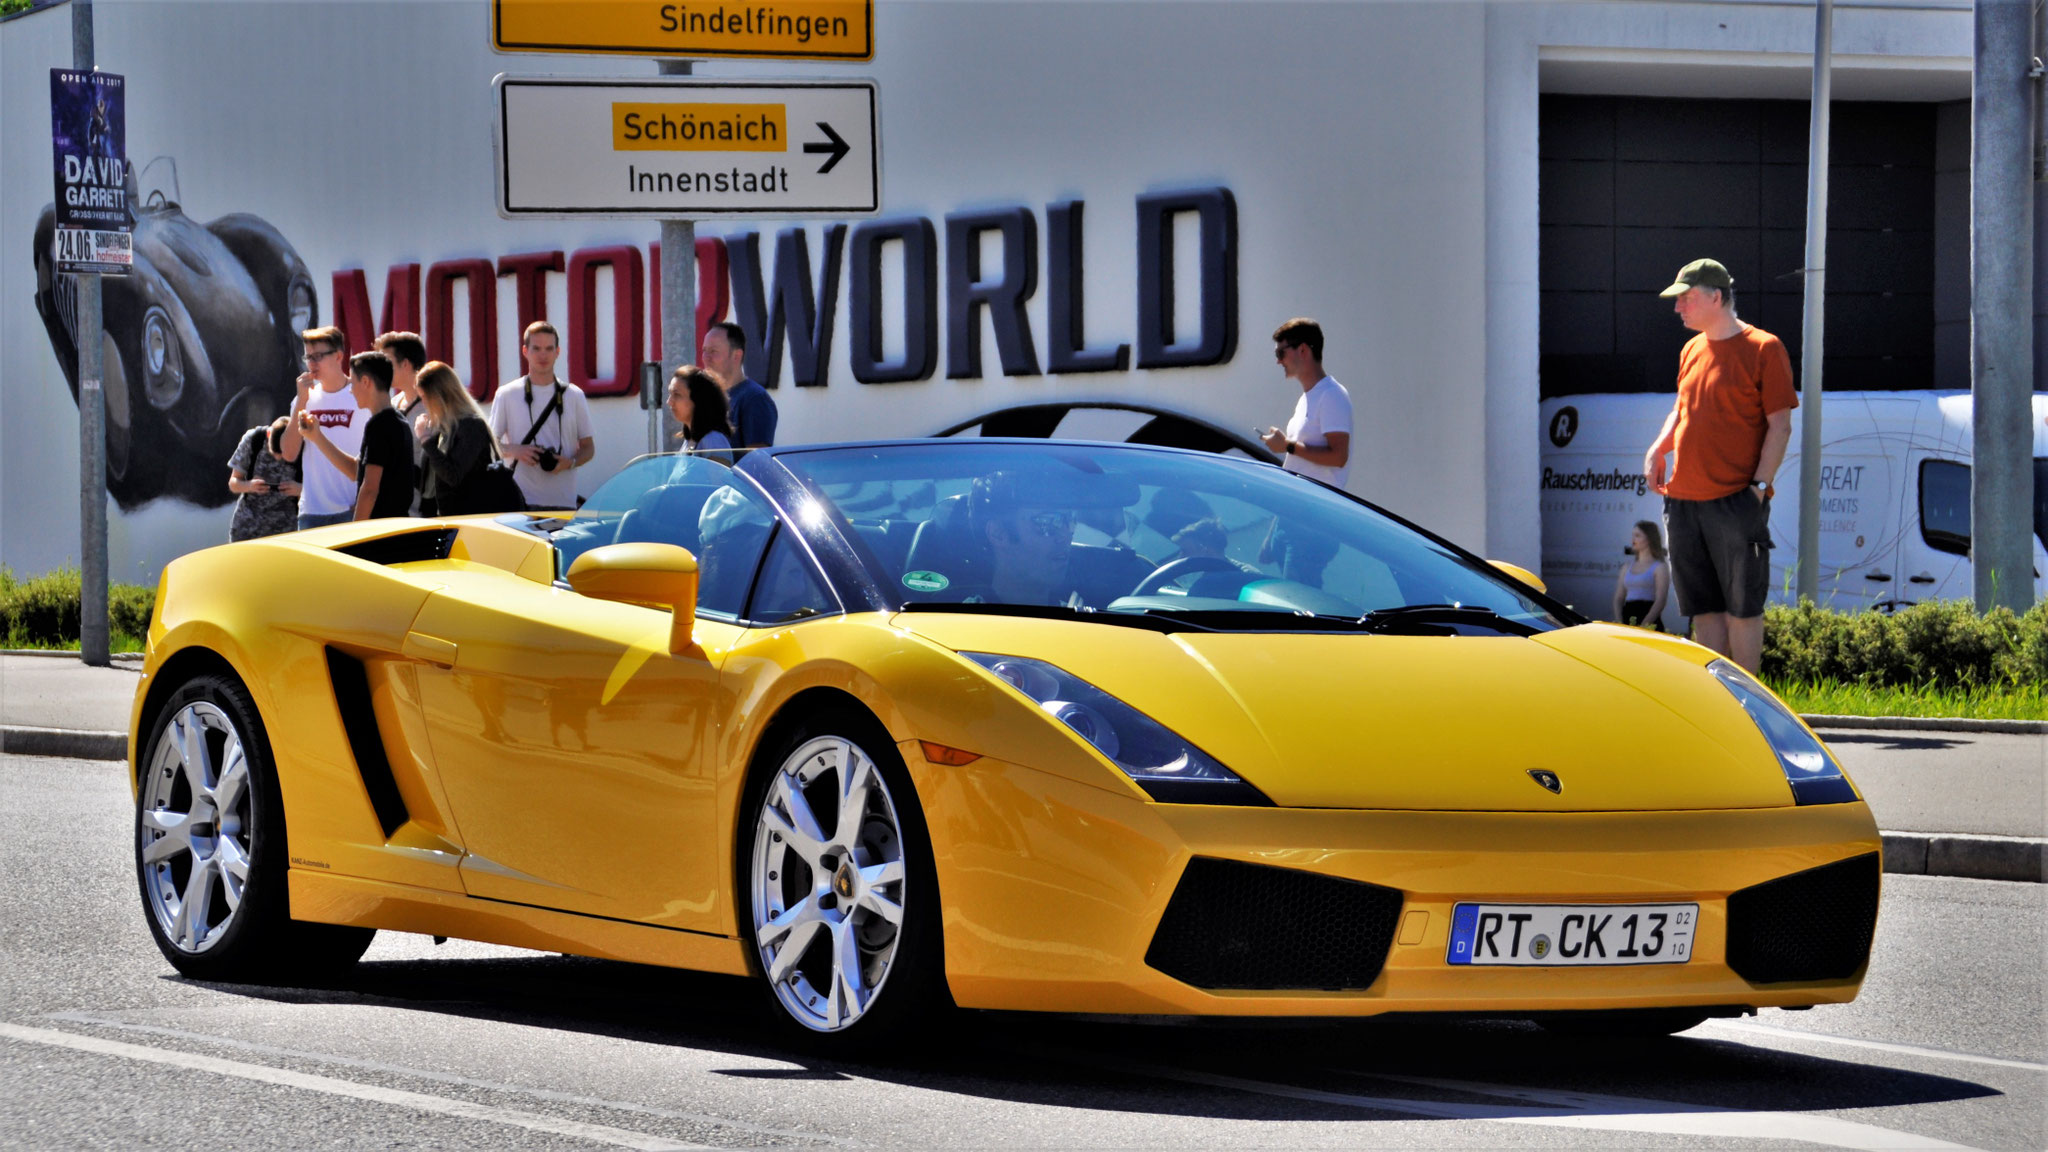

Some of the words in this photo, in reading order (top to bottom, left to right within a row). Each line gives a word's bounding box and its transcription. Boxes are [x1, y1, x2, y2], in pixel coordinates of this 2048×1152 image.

[660, 4, 848, 43] Sindelfingen
[61, 73, 87, 83] OPEN
[91, 76, 104, 85] AIR
[106, 78, 120, 87] 2017
[624, 113, 777, 141] Schönaich
[64, 154, 123, 187] DAVID
[629, 165, 788, 193] Innenstadt
[65, 186, 125, 209] GARRETT
[59, 230, 94, 261] 24.06.
[94, 232, 131, 250] SINDELFINGEN
[96, 249, 131, 264] hofmeister
[332, 186, 1239, 404] MOTORWORLD
[1541, 466, 1647, 496] Rauschenberg
[1820, 465, 1864, 490] REAT
[1819, 498, 1859, 514] MENTS
[1819, 520, 1857, 532] ELLENCE
[1675, 911, 1691, 925] 02
[1456, 940, 1465, 953] D
[1474, 913, 1532, 958] RT
[1558, 913, 1613, 958] CK
[1616, 913, 1668, 958] 13
[1672, 942, 1686, 956] 10
